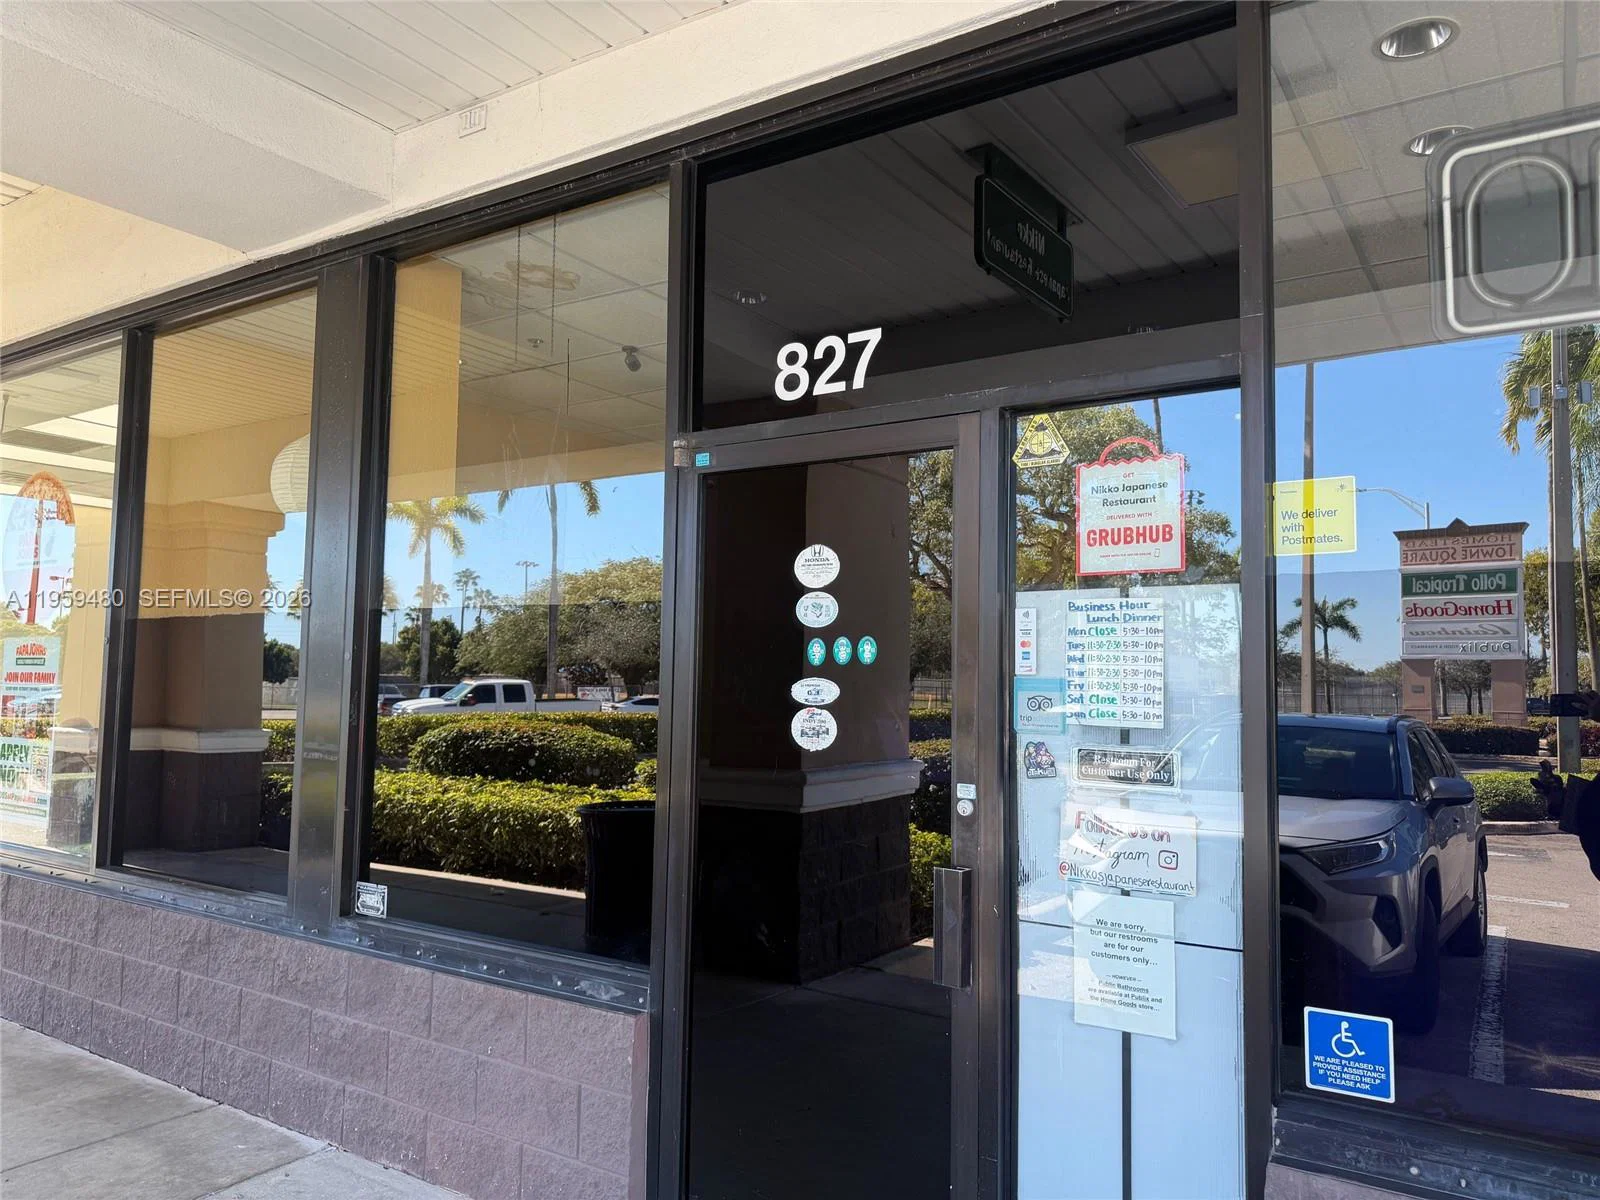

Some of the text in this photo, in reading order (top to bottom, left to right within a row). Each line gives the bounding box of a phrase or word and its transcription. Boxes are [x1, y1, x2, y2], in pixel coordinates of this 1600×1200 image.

[774, 327, 882, 401] 827
[1091, 481, 1169, 495] Nikko Japanese
[1102, 495, 1157, 507] Restaurant
[1106, 513, 1136, 521] DELIVERED
[1280, 508, 1339, 521] We deliver
[1281, 522, 1305, 533] with
[1086, 523, 1174, 548] GRUBHUB
[1281, 533, 1344, 545] Postmates.
[1068, 600, 1151, 612] Business Hour
[1086, 612, 1163, 623] Lunch Dinner
[1067, 627, 1087, 637] Mon
[1088, 626, 1117, 637] Close
[1067, 641, 1086, 650] Tues
[4, 671, 56, 684] JOIN OUR FAMILY
[1067, 693, 1084, 704] Sat
[1088, 694, 1118, 705] Close
[1088, 707, 1117, 719] Close
[0, 743, 30, 763] APPLY
[1093, 754, 1156, 768] Restroom For
[1081, 765, 1170, 782] Customer Use Only
[1095, 918, 1109, 927] We
[1109, 921, 1122, 929] are
[1090, 928, 1102, 937] but
[1118, 933, 1159, 944] restrooms
[1117, 942, 1129, 950] for
[1130, 945, 1145, 953] our
[1091, 950, 1158, 966] customers only...
[1116, 983, 1149, 994] Bathrooms
[1100, 997, 1117, 1005] Home
[1117, 999, 1137, 1009] Goods
[1313, 1054, 1385, 1073] WE ARE PLEASED TO
[1312, 1061, 1386, 1080] PROVIDE ASSISTANCE
[1326, 1070, 1341, 1078] YOU
[1341, 1073, 1361, 1082] NEED
[1361, 1076, 1381, 1085] HELP
[1328, 1077, 1371, 1090] PLEASE ASK
